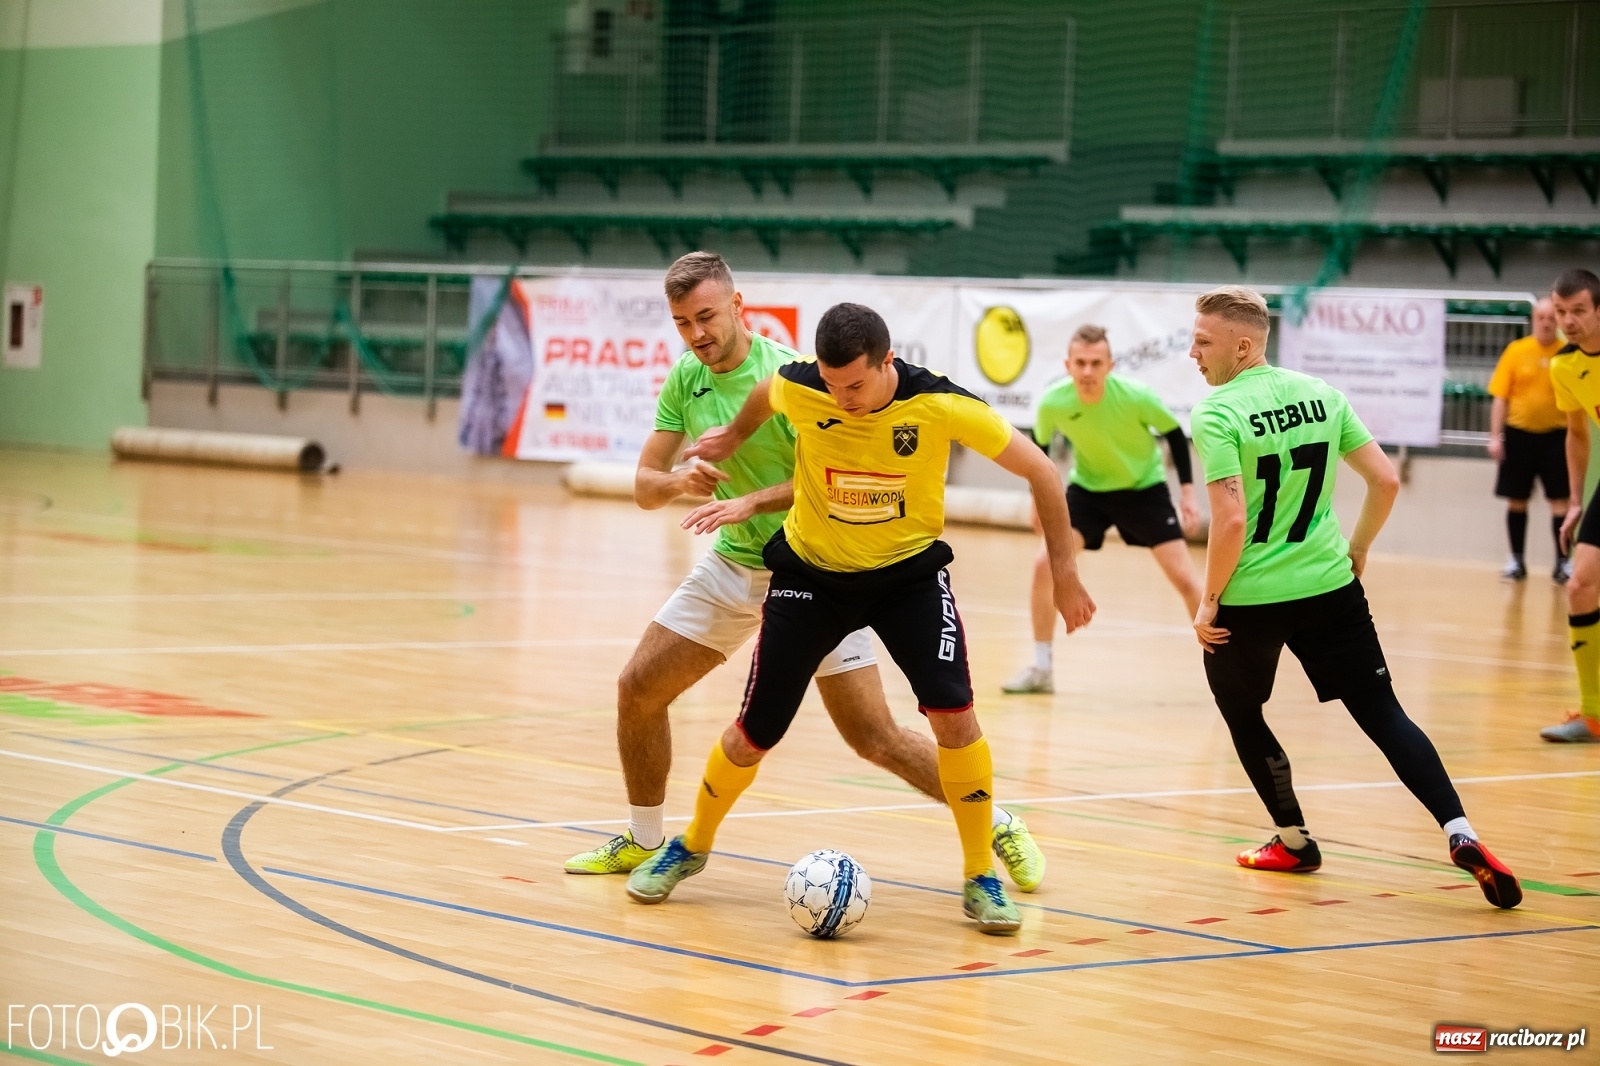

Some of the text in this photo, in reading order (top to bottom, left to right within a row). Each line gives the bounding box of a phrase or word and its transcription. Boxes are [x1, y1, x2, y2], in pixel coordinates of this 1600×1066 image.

[544, 336, 671, 369] PRACA
[1250, 400, 1327, 437] STEBLU
[827, 487, 905, 507] SILESIAWORK
[1251, 441, 1330, 544] 17
[771, 589, 813, 600] GIVOVA
[938, 570, 957, 662] GIVOVA
